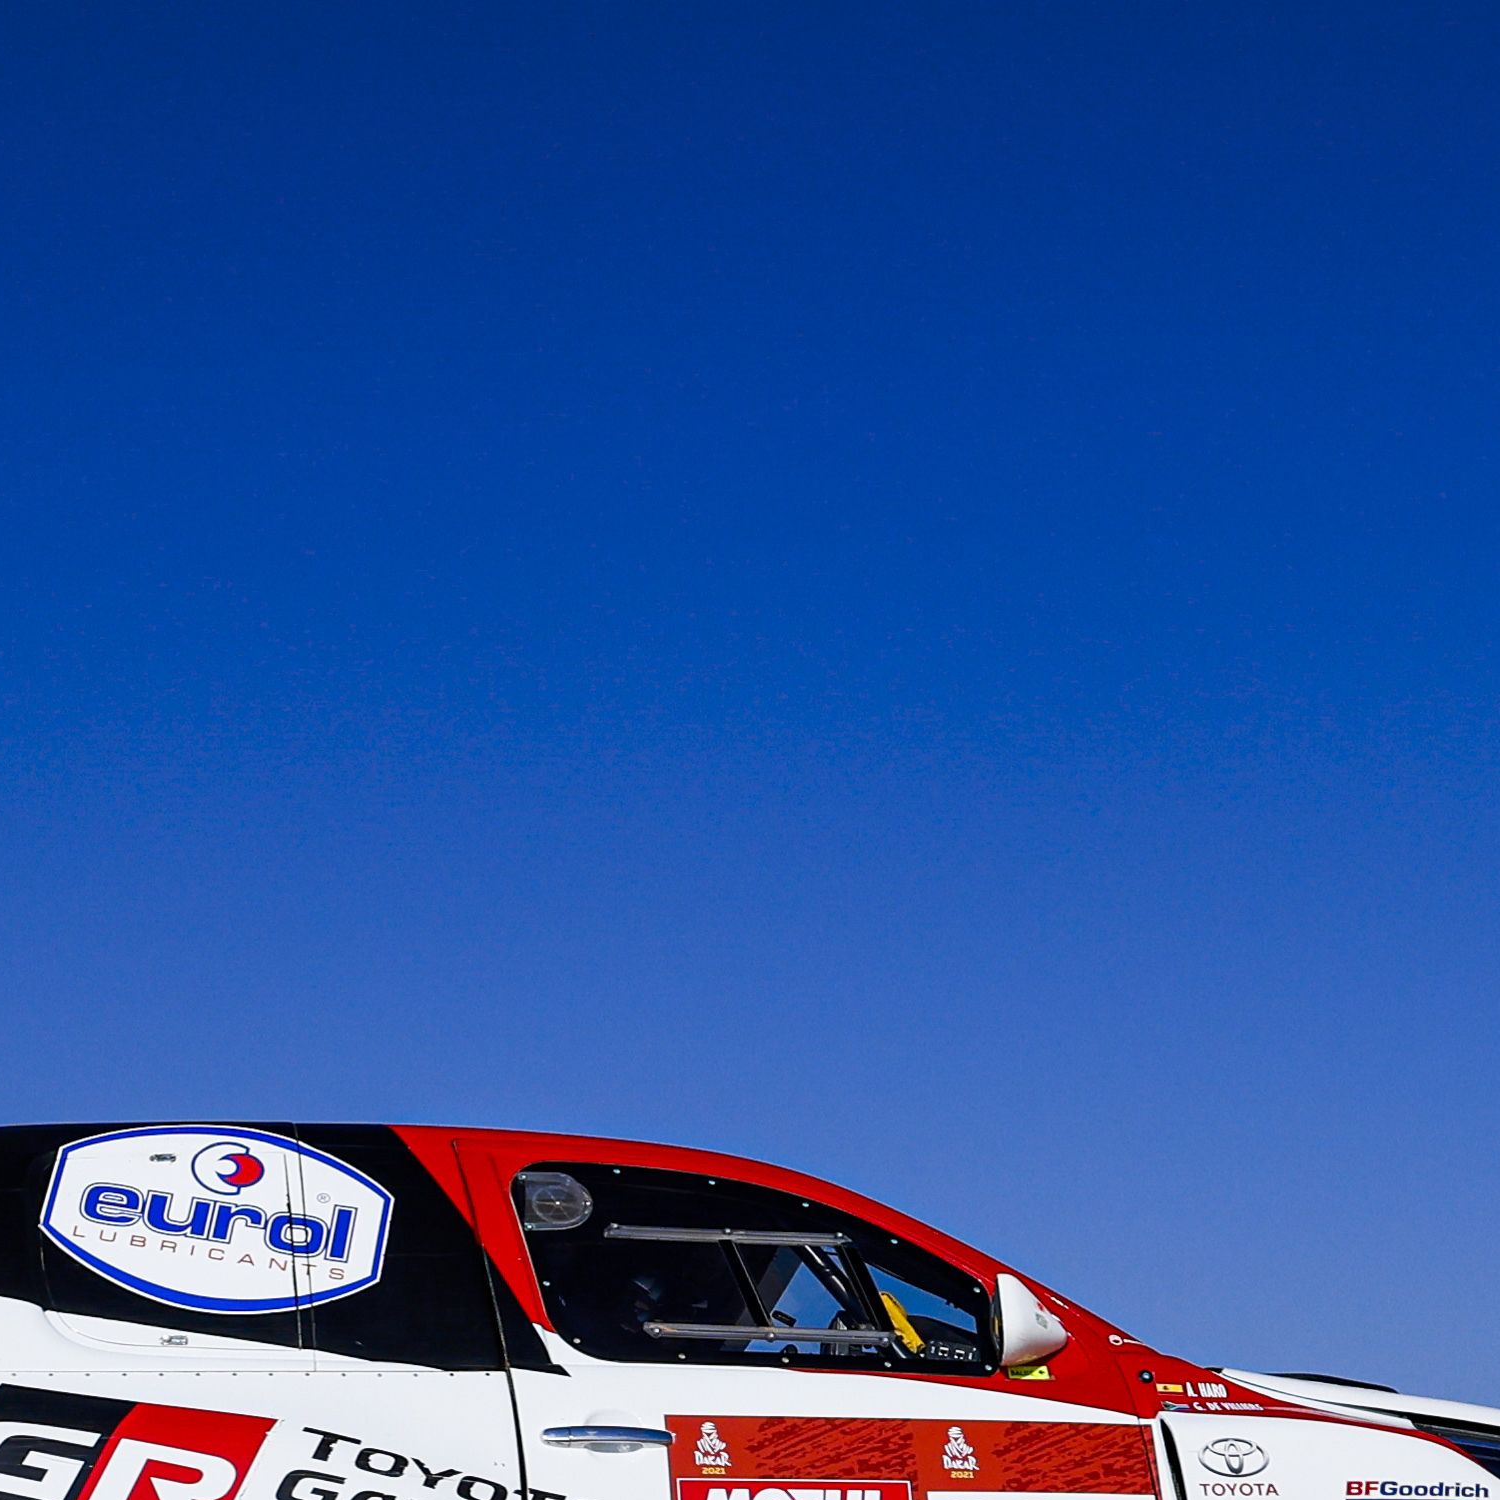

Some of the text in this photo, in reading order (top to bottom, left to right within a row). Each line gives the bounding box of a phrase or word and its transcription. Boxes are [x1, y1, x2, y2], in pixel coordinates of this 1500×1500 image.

[79, 1182, 358, 1263] eurol
[73, 1224, 346, 1281] LUBRICANTS
[1198, 1382, 1228, 1399] HARO
[693, 1450, 732, 1467] DAKAR
[942, 1455, 980, 1471] DAKAR
[701, 1467, 727, 1475] 2021
[950, 1470, 975, 1479] 2021
[1200, 1483, 1280, 1497] TOYOTA
[1345, 1481, 1490, 1498] BFGoodrich
